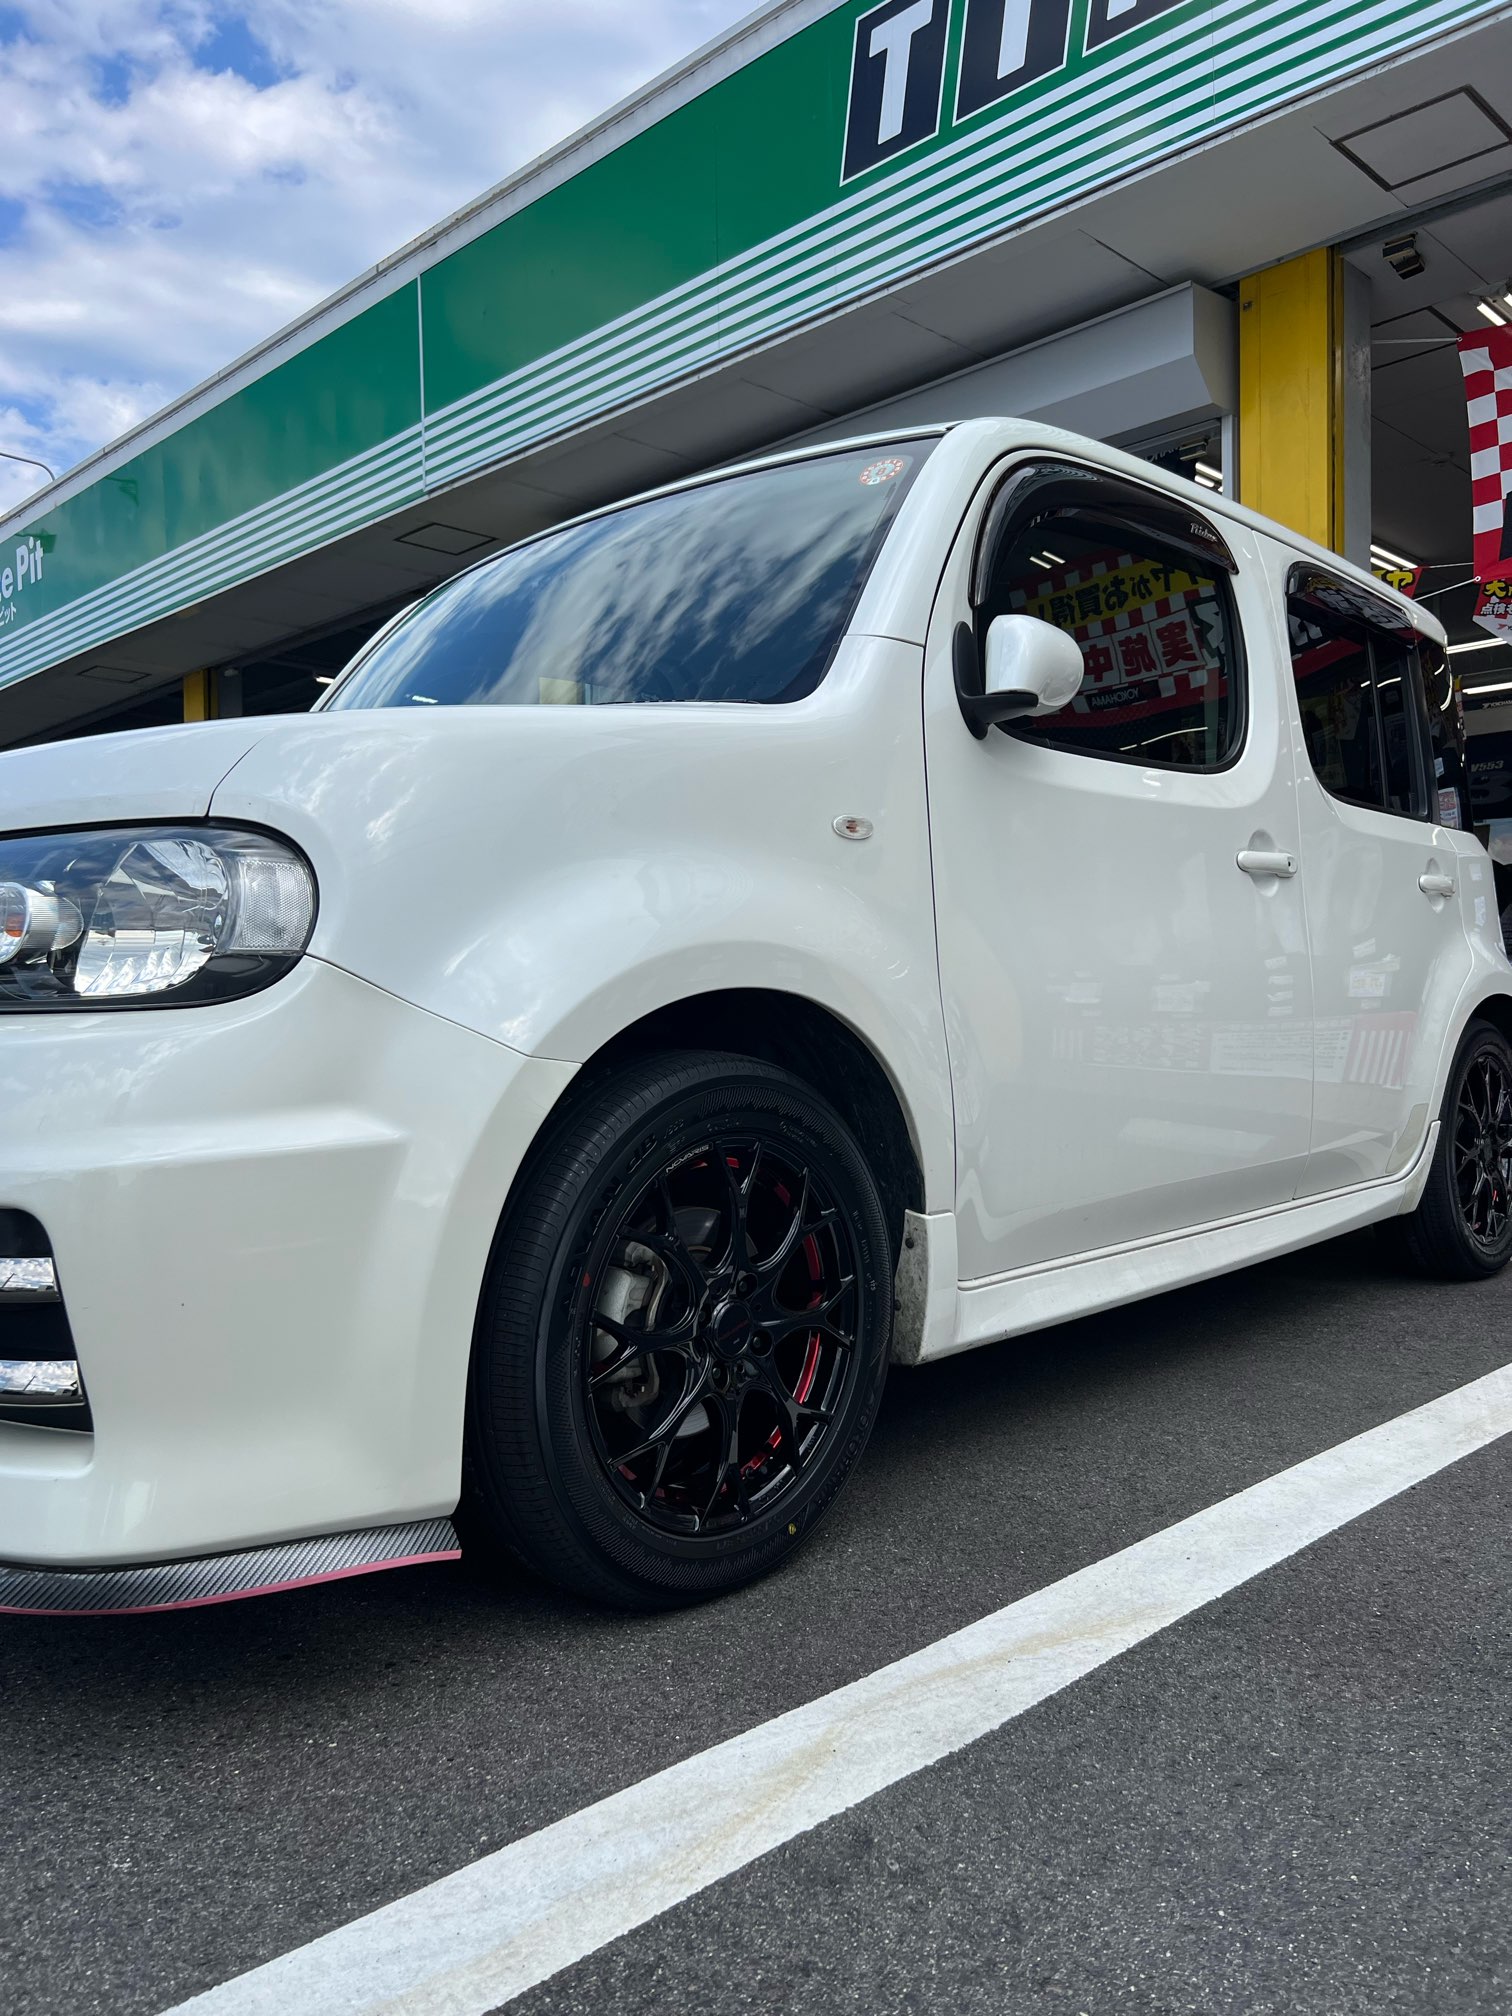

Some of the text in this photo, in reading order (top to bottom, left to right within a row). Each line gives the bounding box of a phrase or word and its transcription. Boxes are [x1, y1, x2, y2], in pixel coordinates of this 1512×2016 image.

[869, 0, 1138, 145] TI
[16, 536, 43, 592] Pit
[1484, 580, 1512, 597] 大
